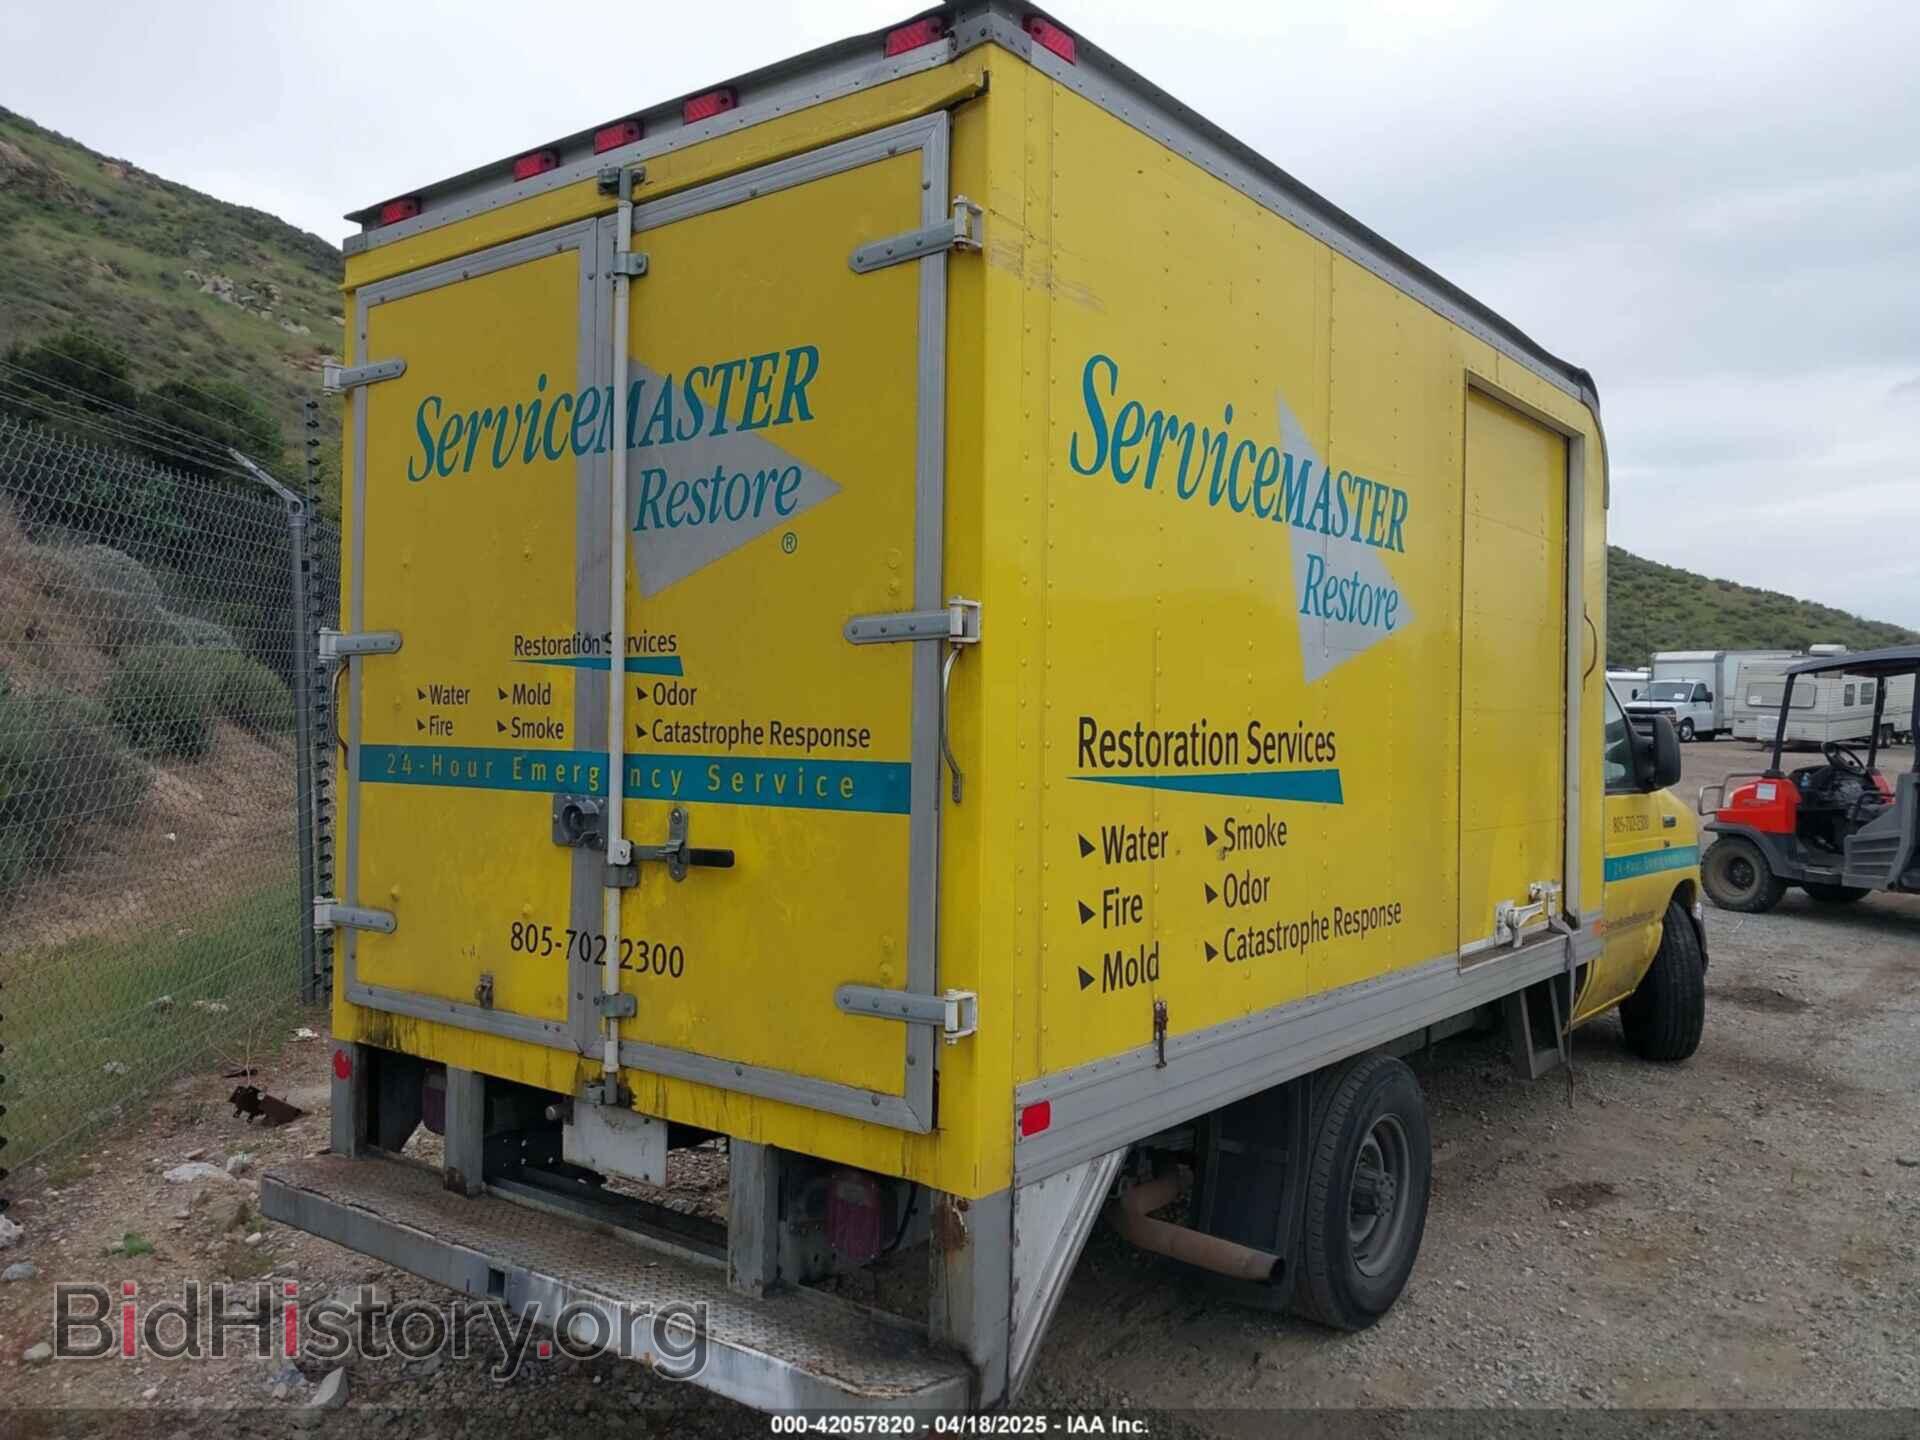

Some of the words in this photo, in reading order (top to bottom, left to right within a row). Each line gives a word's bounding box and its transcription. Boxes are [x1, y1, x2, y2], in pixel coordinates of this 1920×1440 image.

[1070, 354, 1408, 553] ServiceMASTER
[632, 465, 802, 531] Restore
[1300, 553, 1398, 630] Restore
[514, 632, 600, 656] Restoration
[603, 629, 677, 654] Srvices
[429, 684, 470, 706] Water
[512, 682, 551, 706] Mold
[652, 681, 697, 706] Odor
[428, 716, 454, 737] Fire
[511, 716, 564, 741] Smoke
[651, 719, 764, 748] Catastrophe
[769, 720, 871, 752] Response
[1078, 716, 1238, 769] Restoration
[1246, 719, 1336, 765] Services
[386, 752, 493, 779] 24-Hour
[512, 756, 682, 796] Emergncy
[707, 766, 855, 799] Service
[1102, 824, 1168, 865] Water
[1223, 813, 1287, 852] Smoke
[1102, 886, 1143, 929] Fire
[1223, 869, 1270, 908] Odor
[510, 921, 684, 978] 805-7022300
[1223, 911, 1329, 964] Catastrophe
[1333, 902, 1402, 939] Response
[1102, 941, 1160, 993] Mold
